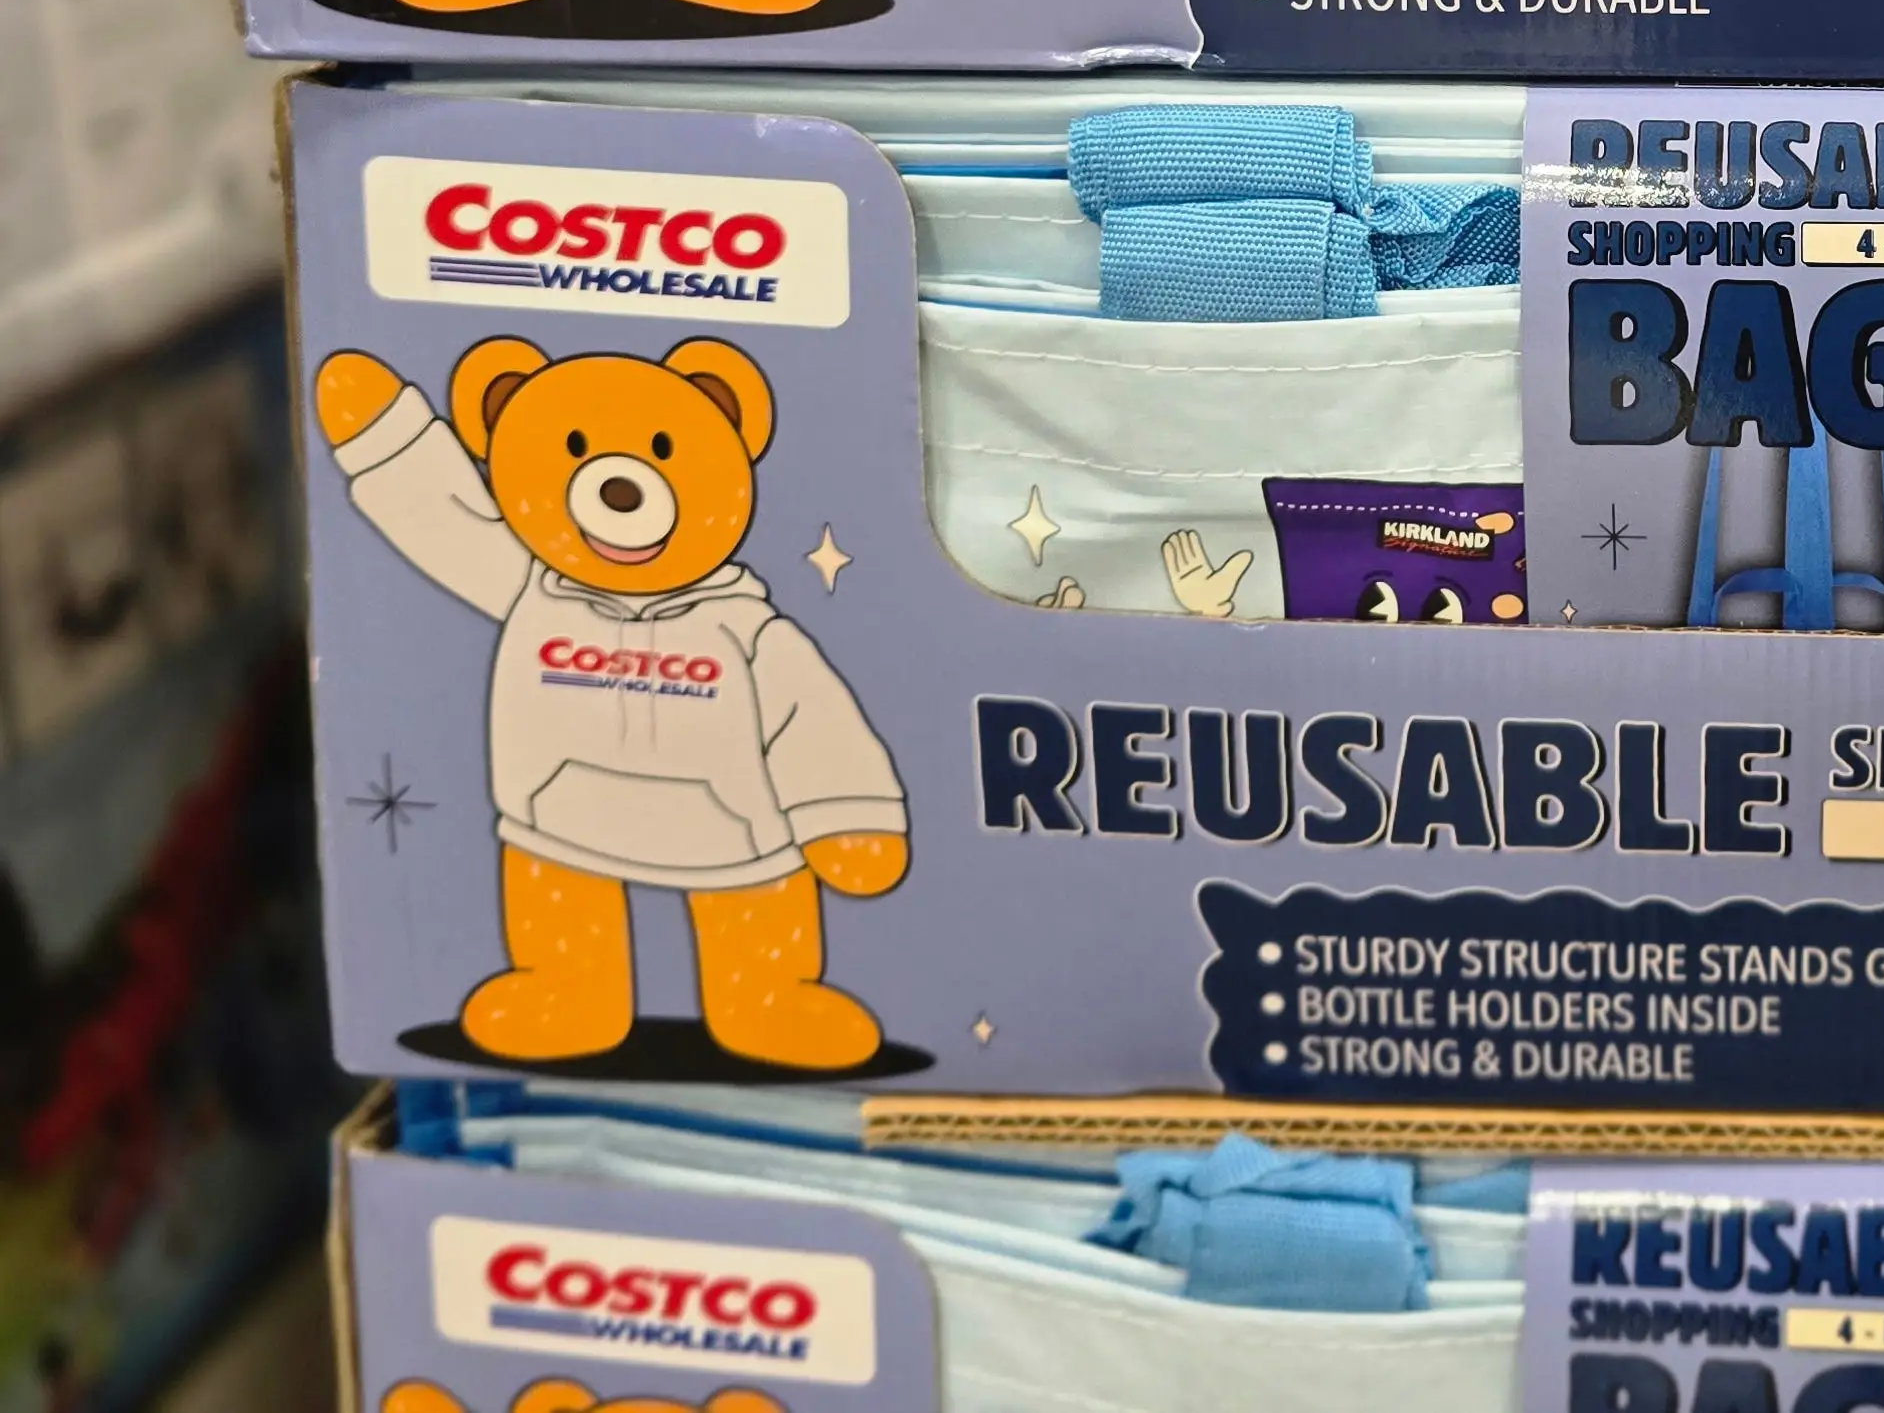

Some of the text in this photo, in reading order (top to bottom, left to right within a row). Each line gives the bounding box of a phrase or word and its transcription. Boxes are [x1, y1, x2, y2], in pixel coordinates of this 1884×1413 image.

[424, 183, 788, 270] COSTCO
[1566, 220, 1797, 267] SHOPPING
[1856, 229, 1877, 259] 4
[538, 262, 780, 304] WHOLESALE
[1383, 521, 1490, 549] KIRKLAND
[537, 637, 723, 684] COSTCO
[972, 693, 1792, 858] REUSABLE
[1295, 935, 1447, 978] STURDY
[1459, 940, 1687, 983] STRUCTURE
[1698, 944, 1853, 986] STANDS
[1299, 986, 1782, 1035] BOTTLE HOLDERS INSIDE
[1300, 1035, 1696, 1083] STRONG & DURABLE
[486, 1243, 818, 1331] COSTCO
[586, 1316, 811, 1362] WHOLESALE
[1568, 1297, 1782, 1349] SHOPPING
[1836, 1322, 1856, 1345] 4
